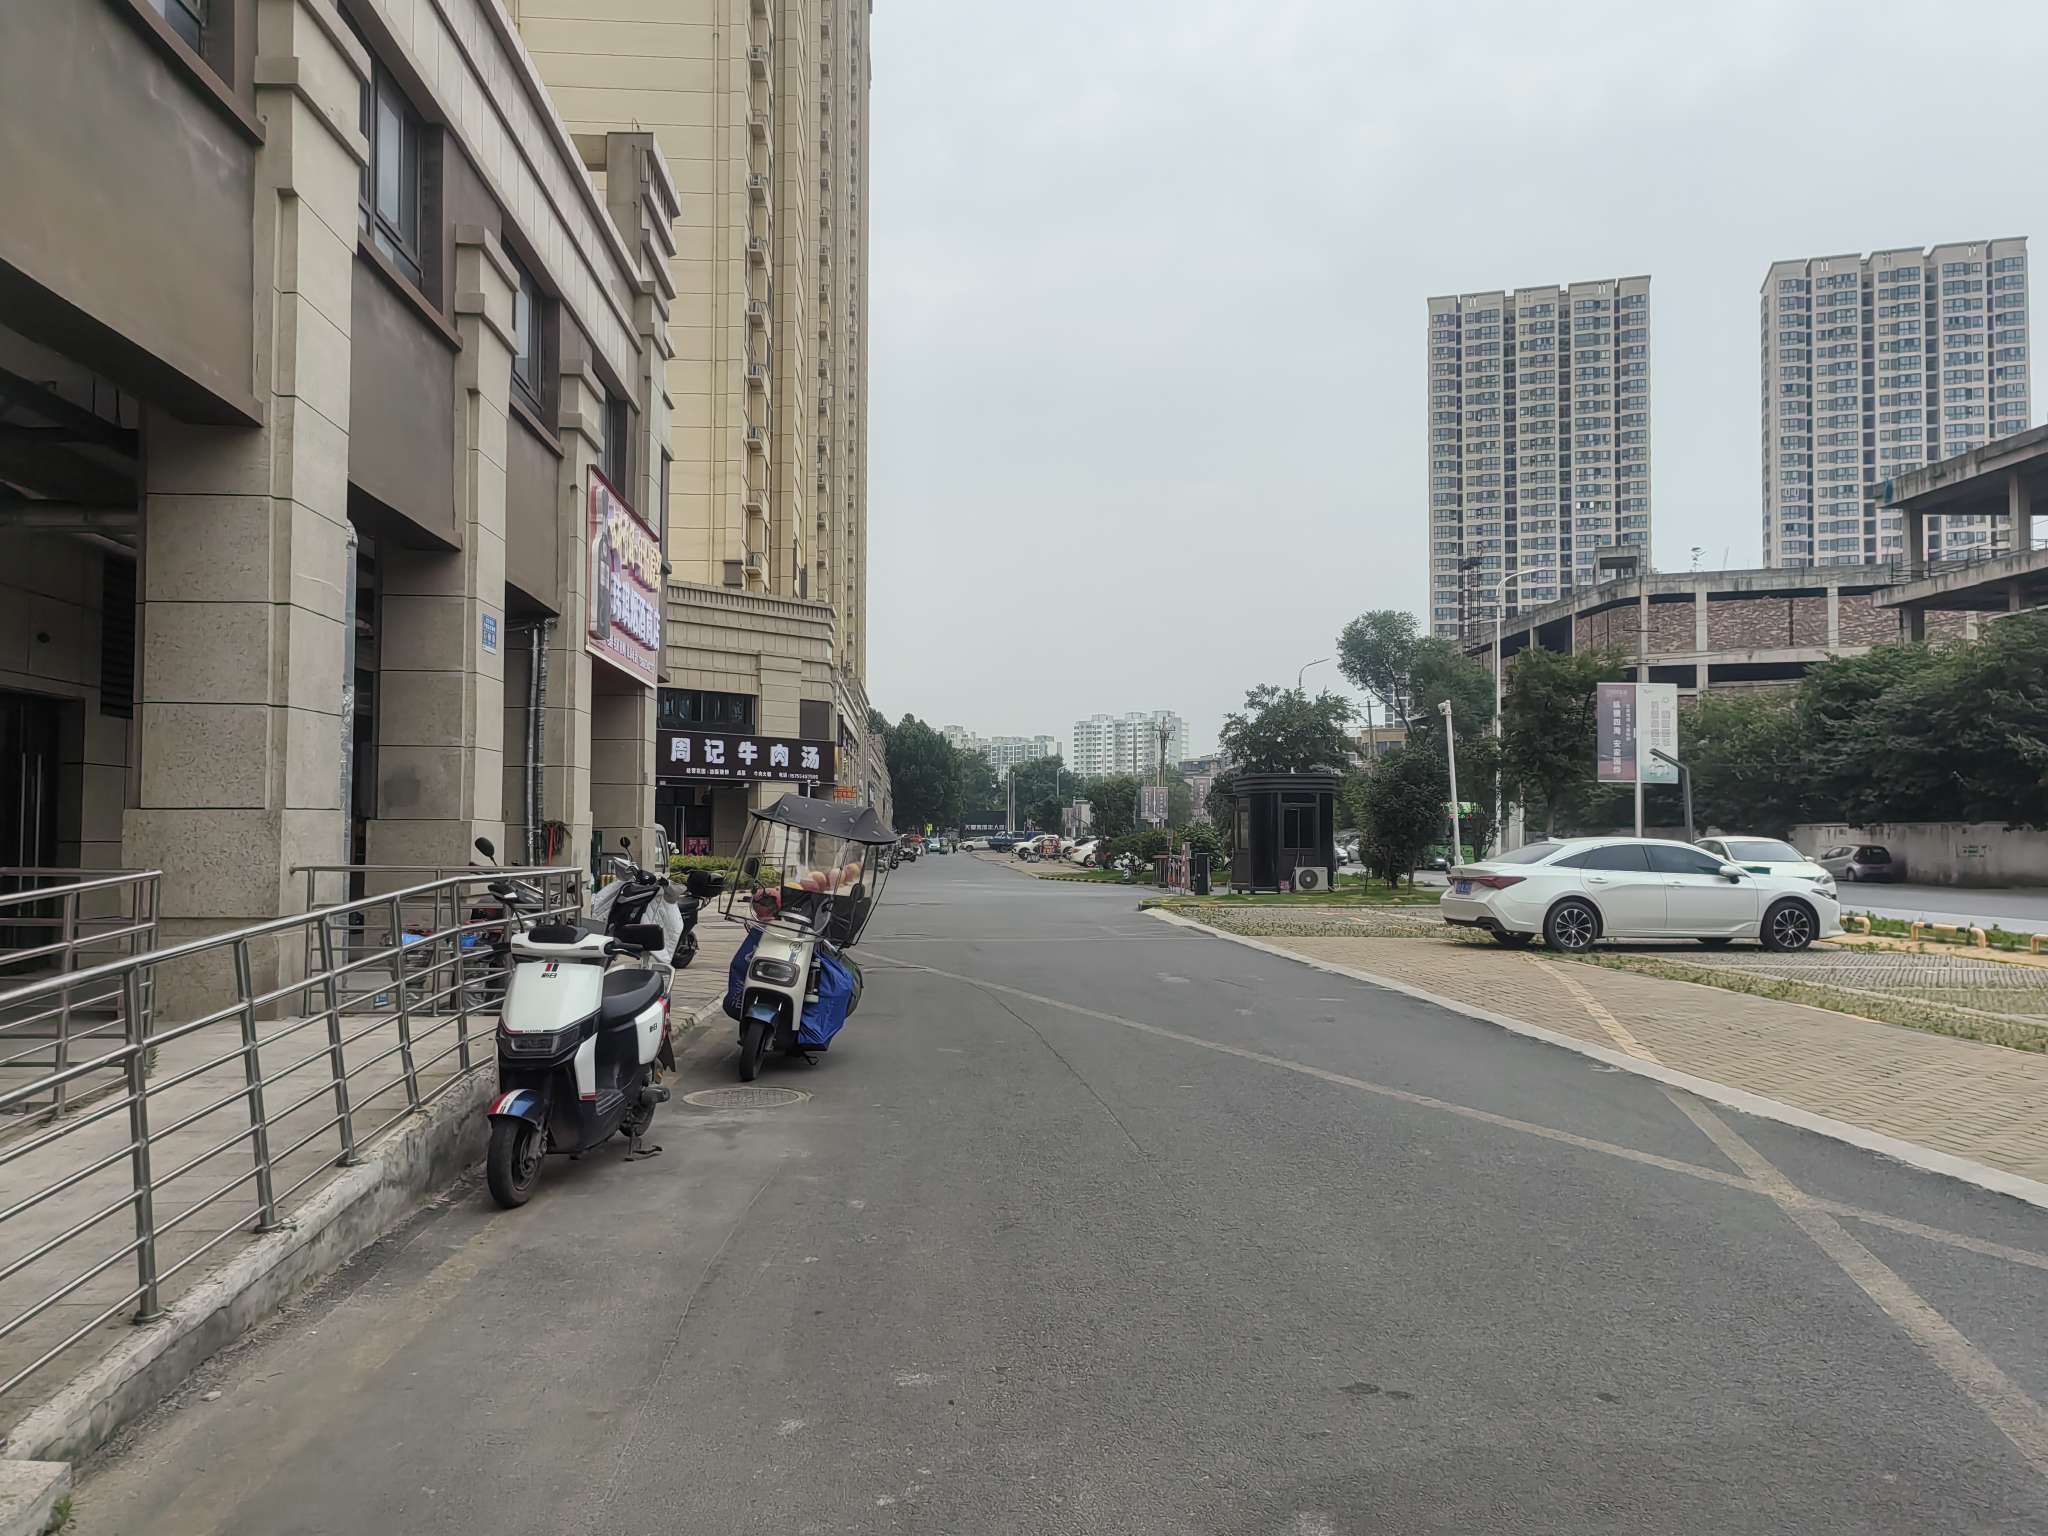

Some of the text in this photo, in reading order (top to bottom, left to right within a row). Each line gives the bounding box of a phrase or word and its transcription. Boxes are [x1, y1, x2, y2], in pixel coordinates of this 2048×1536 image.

[671, 737, 820, 769] 周记牛肉汤
